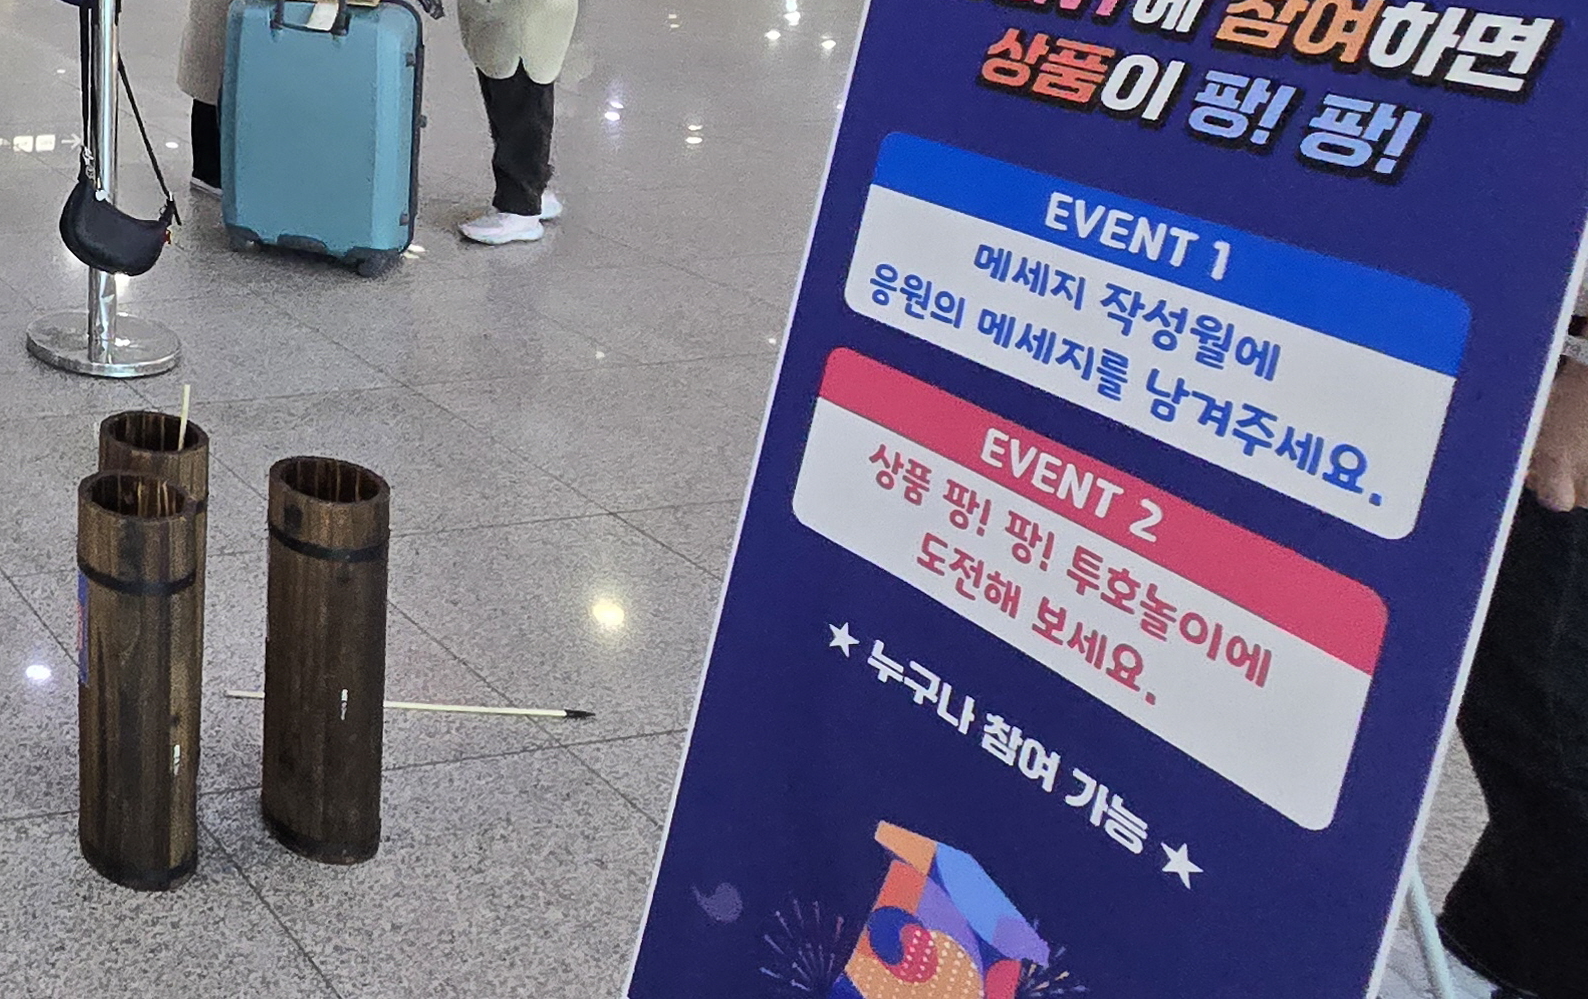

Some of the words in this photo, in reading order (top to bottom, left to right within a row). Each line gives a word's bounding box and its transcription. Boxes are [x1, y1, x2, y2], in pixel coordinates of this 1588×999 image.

[978, 27, 1187, 121] 상품이
[1186, 69, 1297, 145] 팡!
[1298, 92, 1423, 175] 팡!
[972, 242, 1086, 312] 메세지
[1099, 283, 1282, 382] 작성월에
[1044, 190, 1200, 268] EVENT
[1210, 239, 1232, 281] 1
[869, 263, 965, 330] 응원의
[977, 306, 1129, 401] 메세지를
[1144, 368, 1383, 507] 남겨주세요.
[868, 442, 932, 506] 상품
[944, 477, 991, 538] 팡!
[1004, 509, 1056, 572] 팡!
[1066, 543, 1273, 688] 투호놀이에
[979, 427, 1126, 520] EVENT
[1129, 498, 1166, 542] 2
[916, 531, 1021, 618] 도전해
[1031, 597, 1157, 706] 보세요.
[867, 639, 976, 736] 누구나
[981, 712, 1062, 793] 참여
[1064, 768, 1150, 855] 가능
